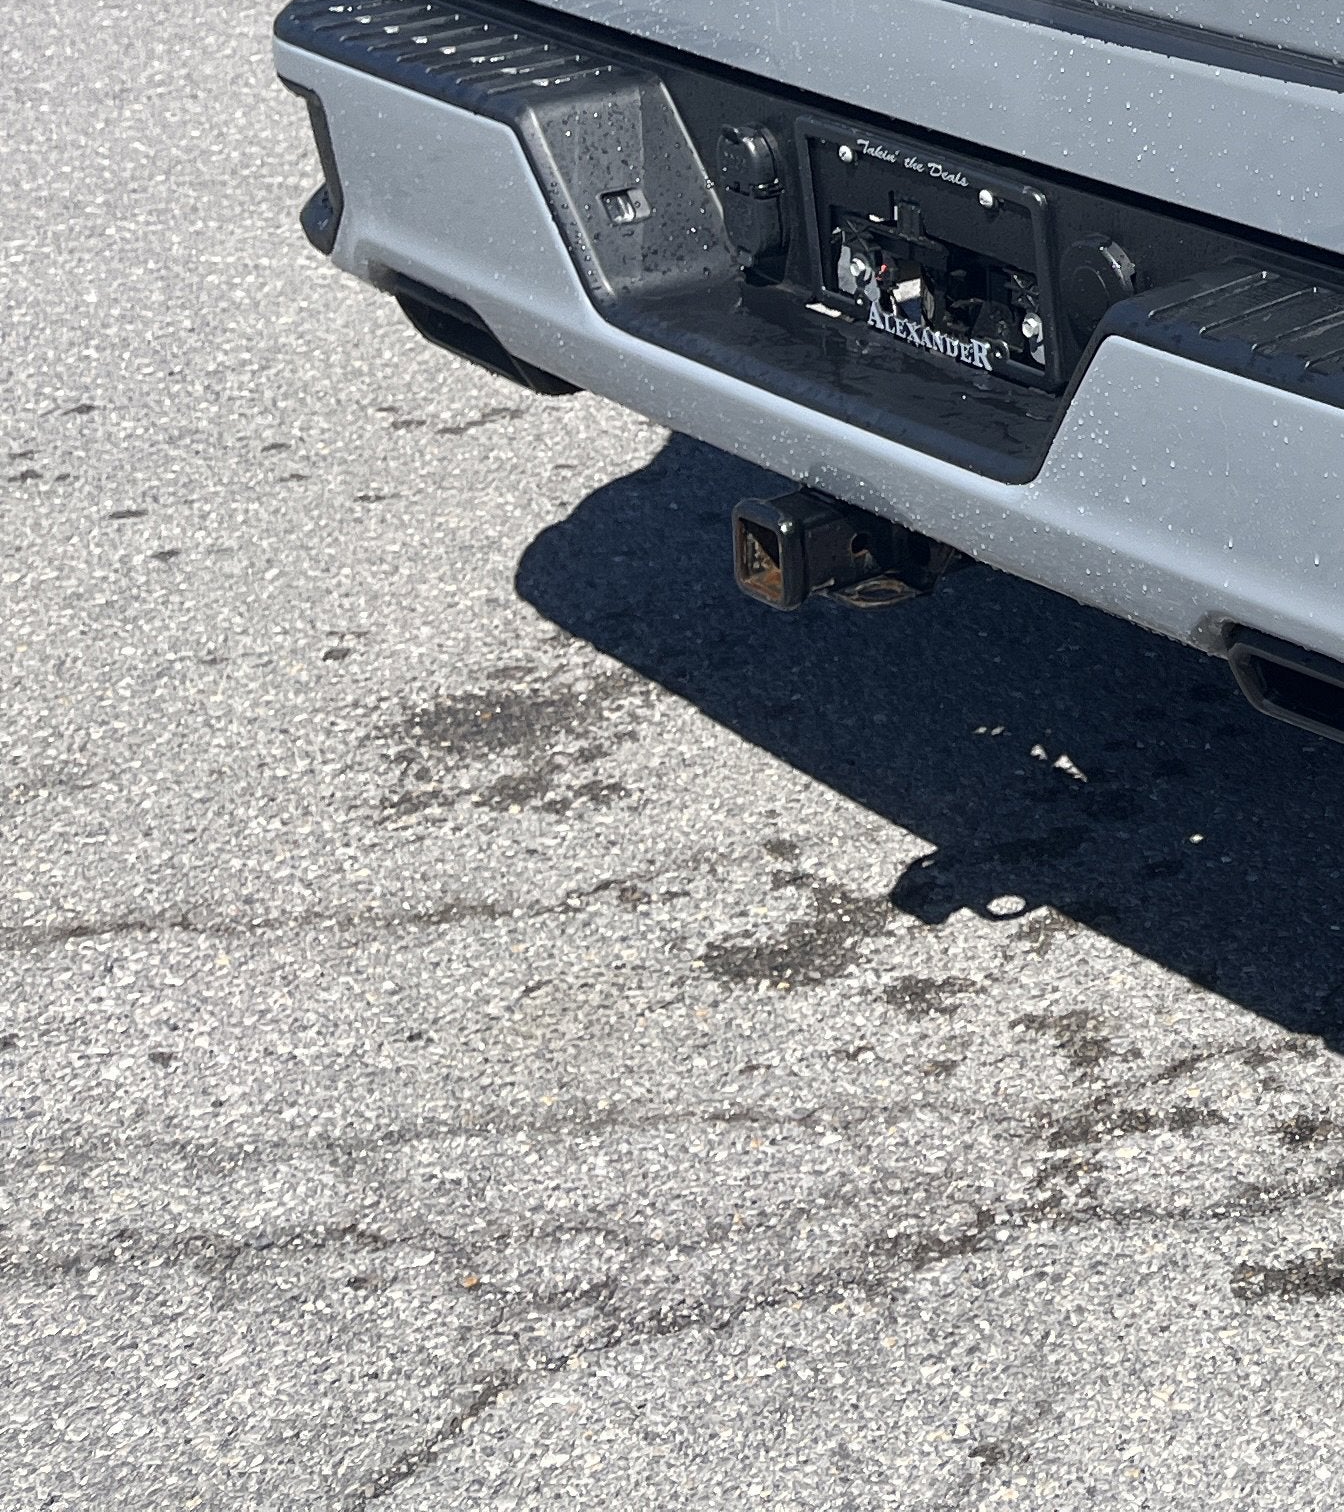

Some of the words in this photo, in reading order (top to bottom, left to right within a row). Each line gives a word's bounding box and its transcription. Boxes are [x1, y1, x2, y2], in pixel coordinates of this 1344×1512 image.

[857, 139, 900, 163] Takin'
[904, 155, 924, 173] the
[928, 162, 969, 187] Deals
[866, 301, 993, 371] ALEXANDER
